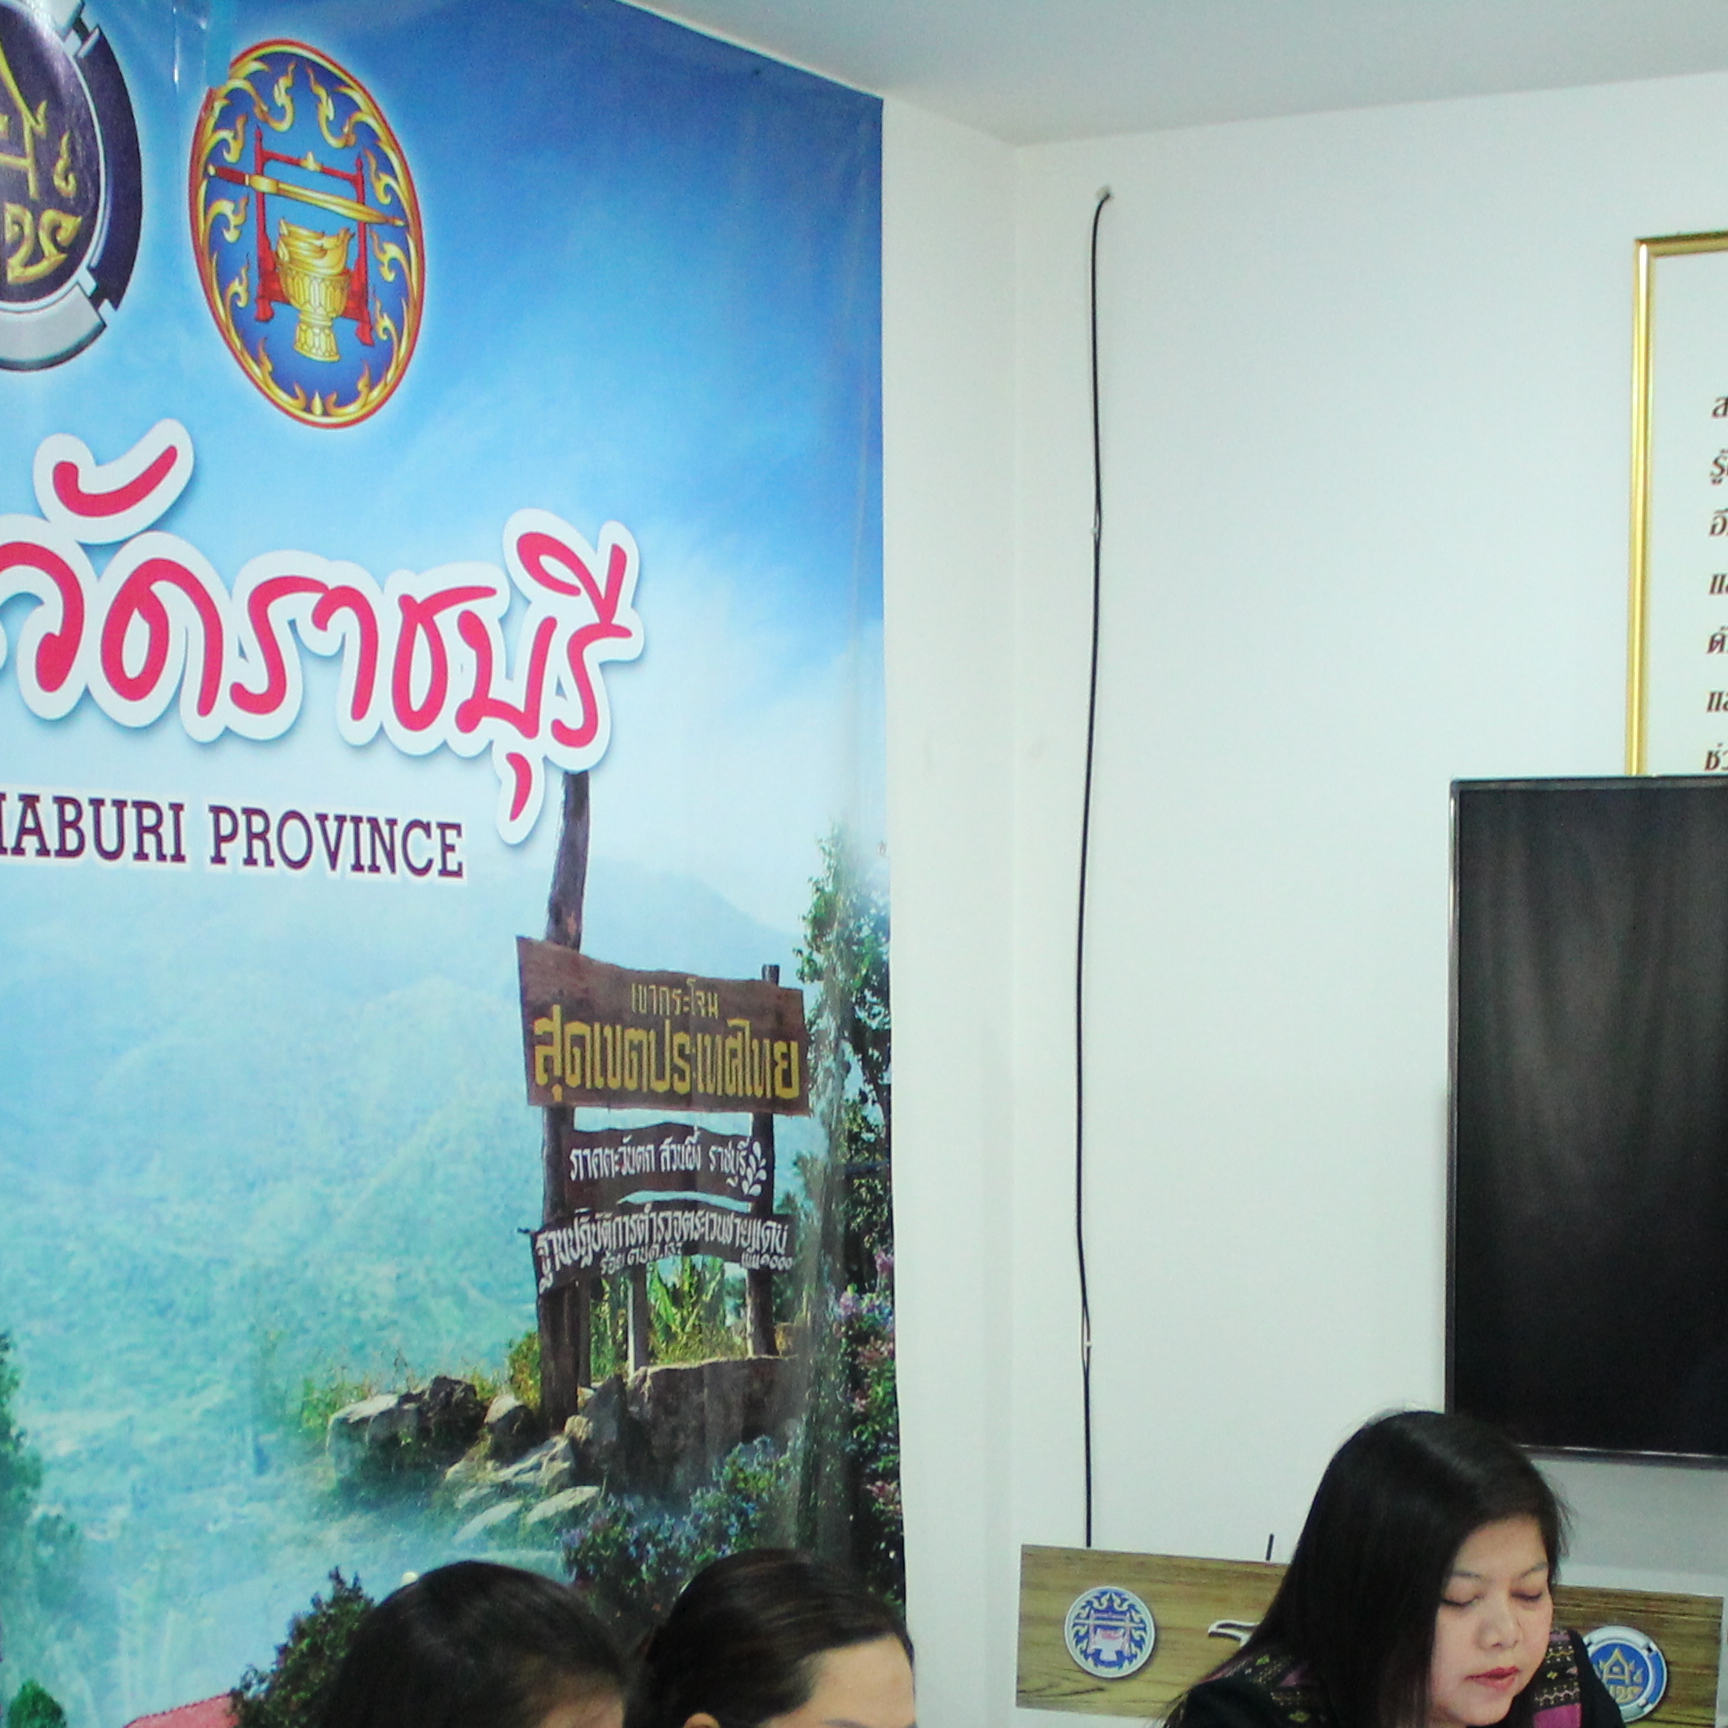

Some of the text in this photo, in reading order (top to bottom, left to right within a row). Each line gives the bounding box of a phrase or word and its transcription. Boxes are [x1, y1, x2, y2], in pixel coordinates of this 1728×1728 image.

[210, 806, 465, 879] PROVINCE
[632, 978, 719, 1018] เขากระโจม
[534, 1004, 800, 1101] สุดเขตประเทศไทย
